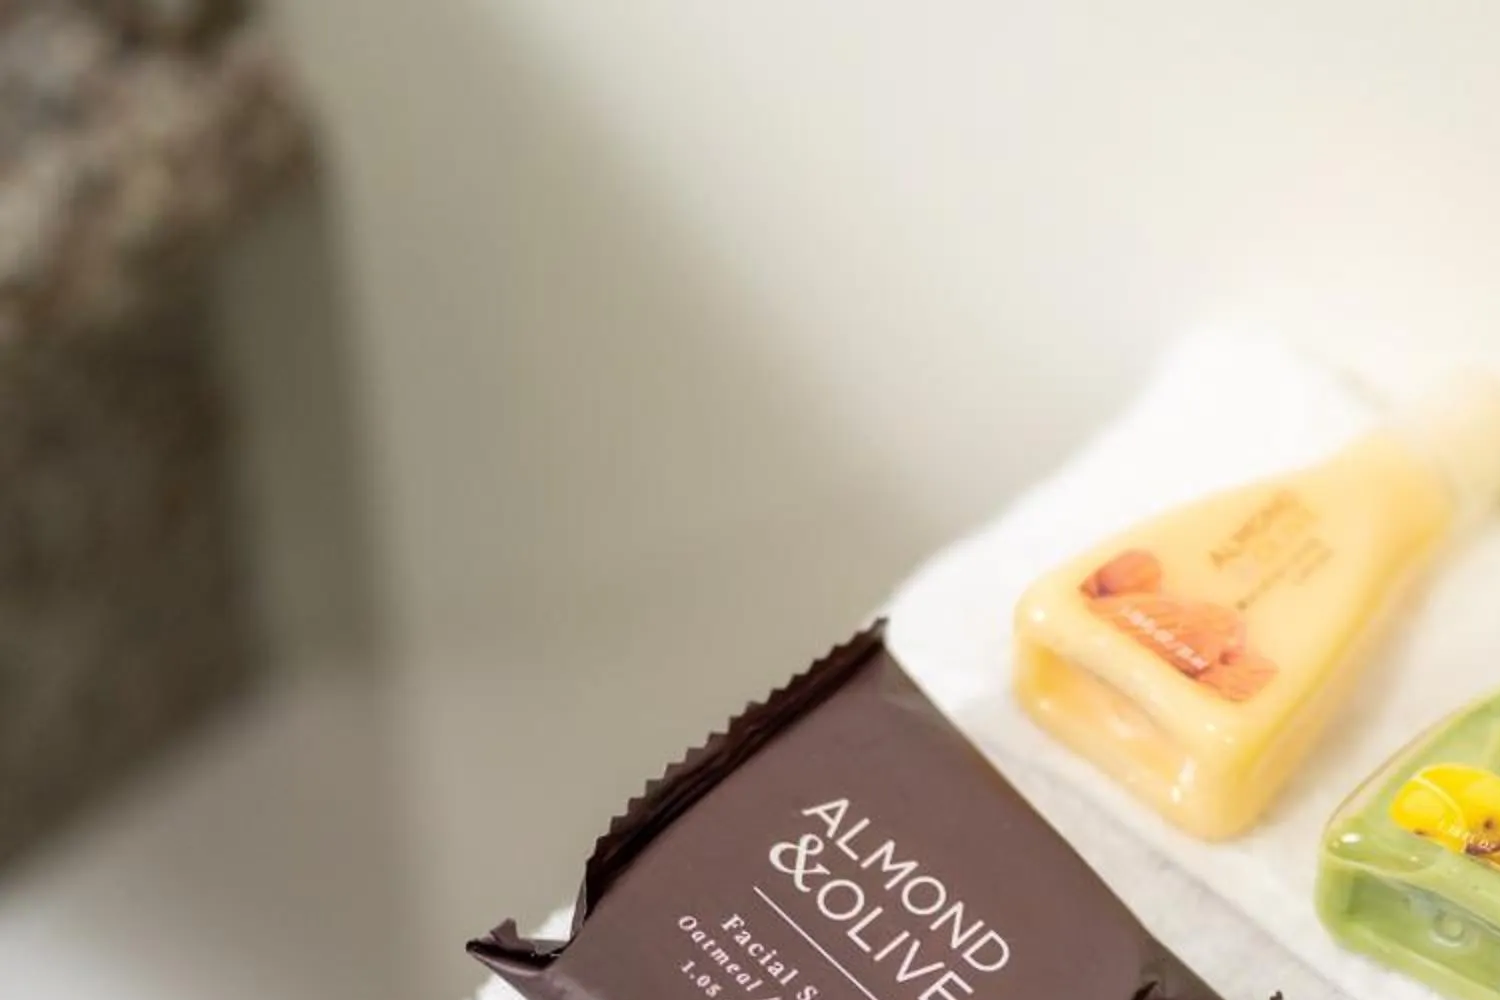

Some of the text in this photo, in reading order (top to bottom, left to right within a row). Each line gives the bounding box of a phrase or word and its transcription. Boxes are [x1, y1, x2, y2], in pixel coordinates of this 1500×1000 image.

[801, 797, 1011, 973] ALMOND
[677, 914, 764, 993] Oatmeal
[680, 959, 722, 1000] 1.05
[720, 913, 799, 987] Facial
